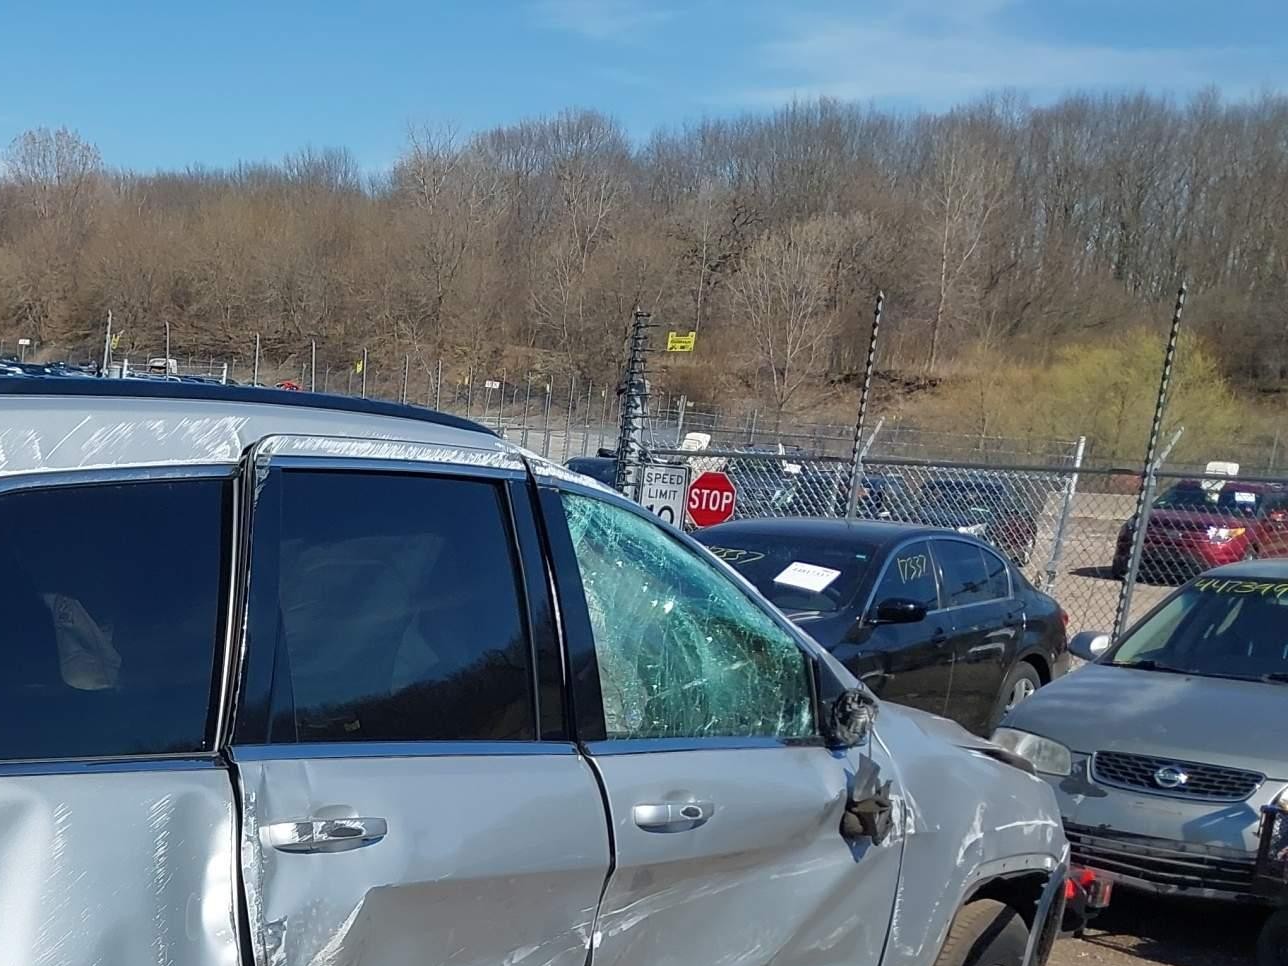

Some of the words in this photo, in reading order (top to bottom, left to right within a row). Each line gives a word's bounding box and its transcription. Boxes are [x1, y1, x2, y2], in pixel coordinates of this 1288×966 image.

[646, 472, 683, 485] SPEED
[648, 488, 678, 501] LIMIT
[689, 488, 733, 512] STOP
